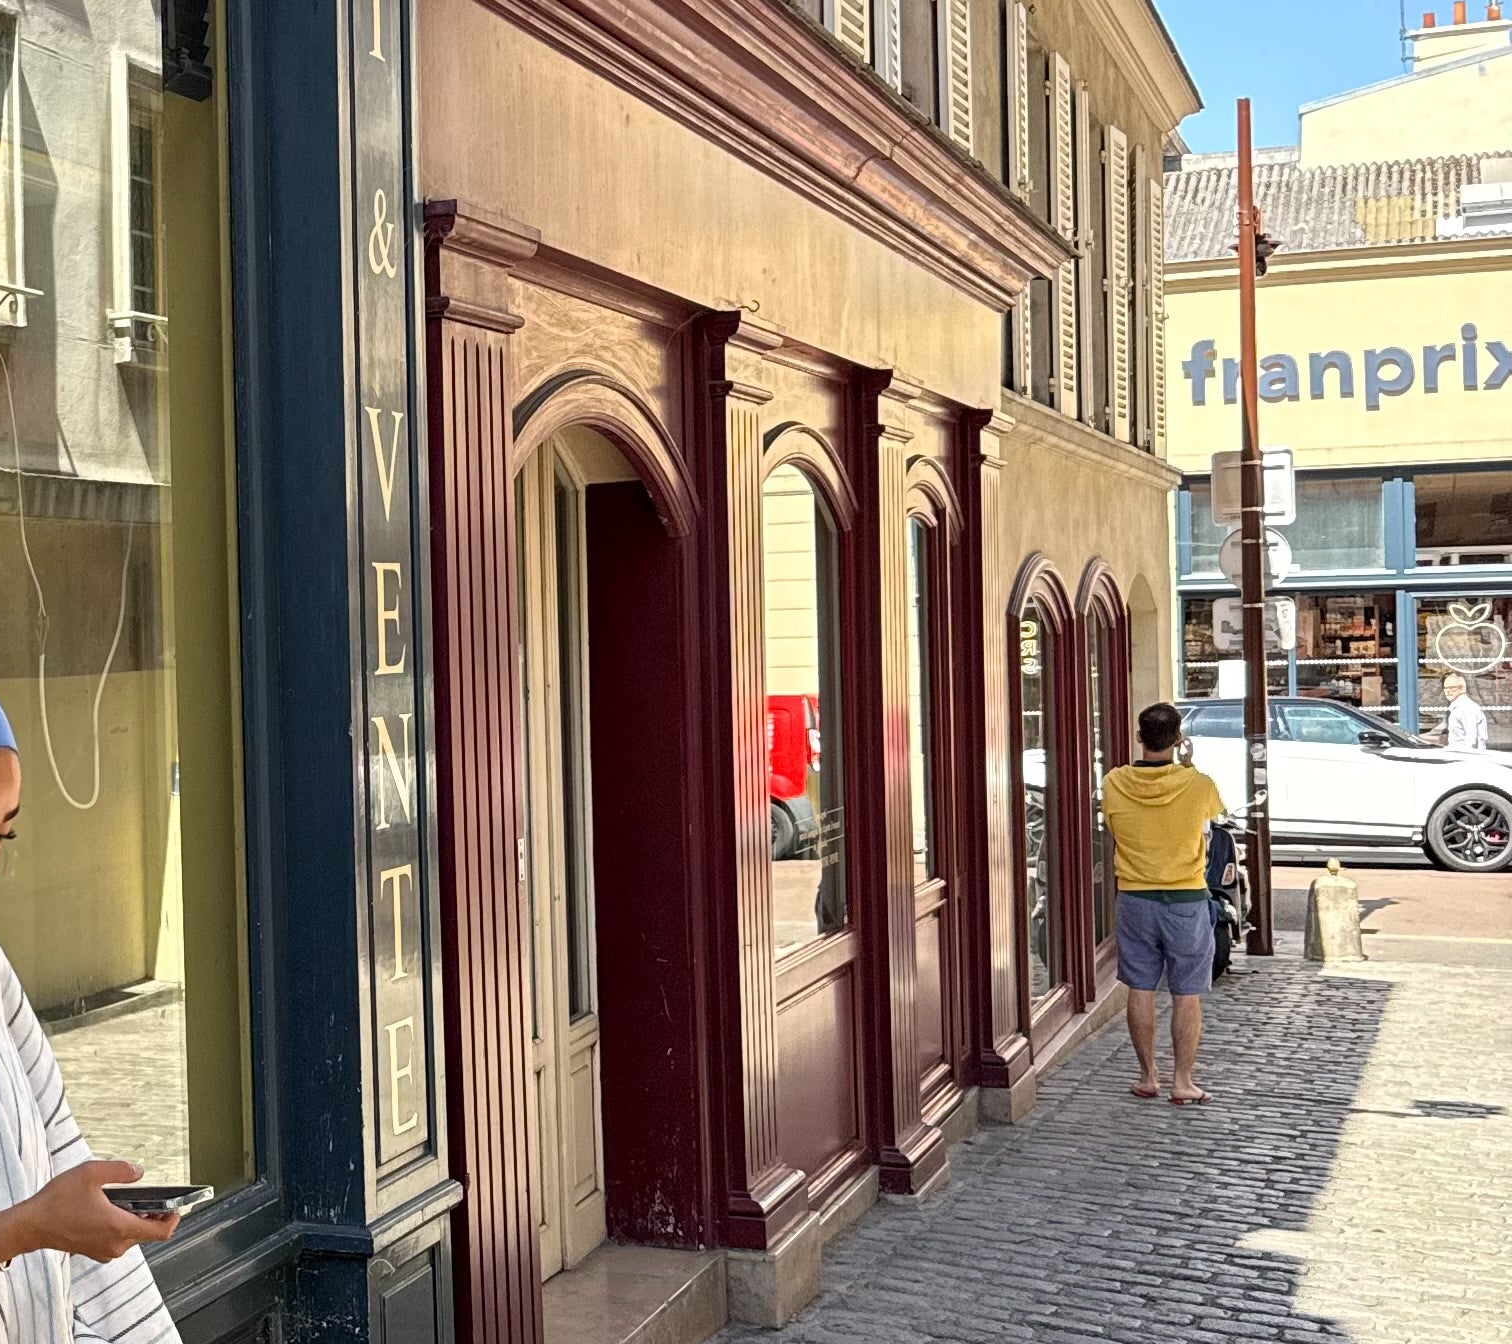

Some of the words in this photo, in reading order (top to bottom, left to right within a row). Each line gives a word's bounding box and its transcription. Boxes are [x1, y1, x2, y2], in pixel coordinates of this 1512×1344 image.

[367, 187, 397, 279] &
[1181, 322, 1512, 412] franprix
[364, 407, 420, 1137] VENTE
